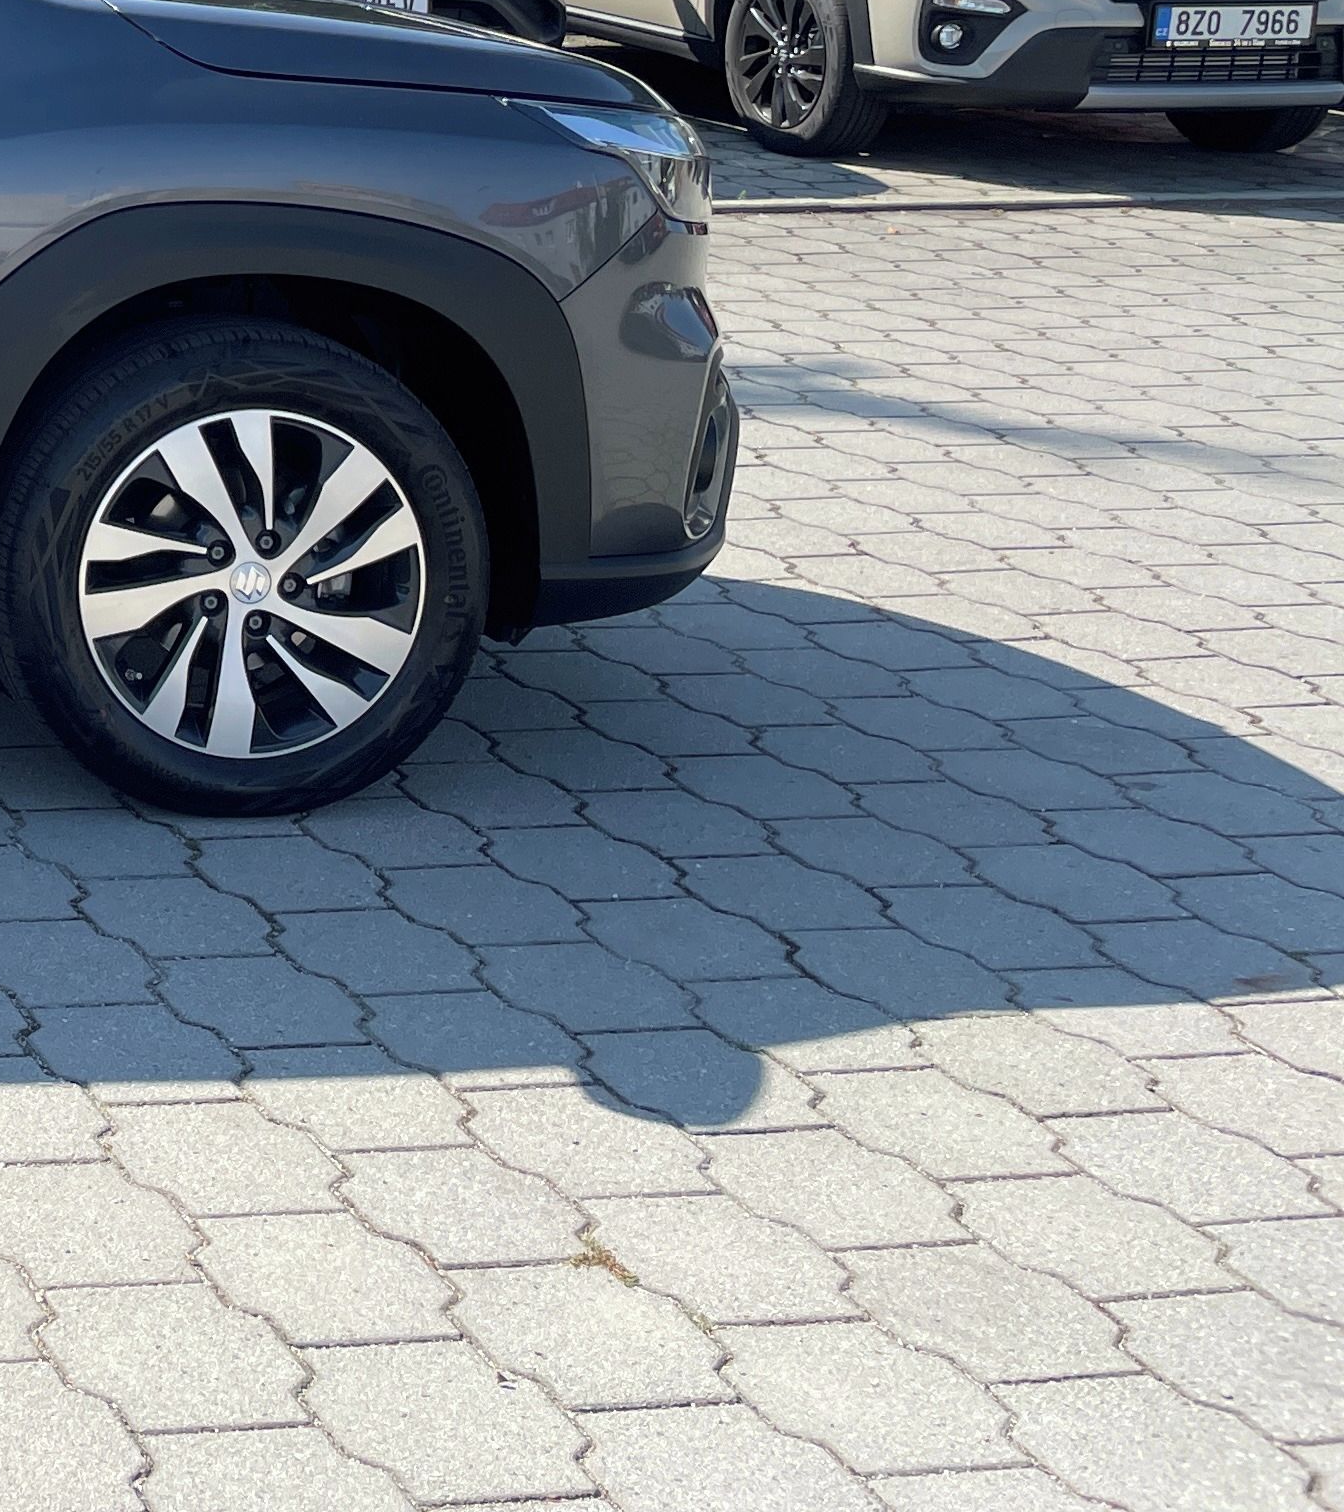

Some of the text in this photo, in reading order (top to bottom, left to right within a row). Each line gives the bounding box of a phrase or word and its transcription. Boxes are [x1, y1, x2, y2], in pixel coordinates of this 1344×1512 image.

[1240, 10, 1300, 36] 7966
[76, 428, 122, 481] 215/55
[418, 463, 471, 618] Continental
